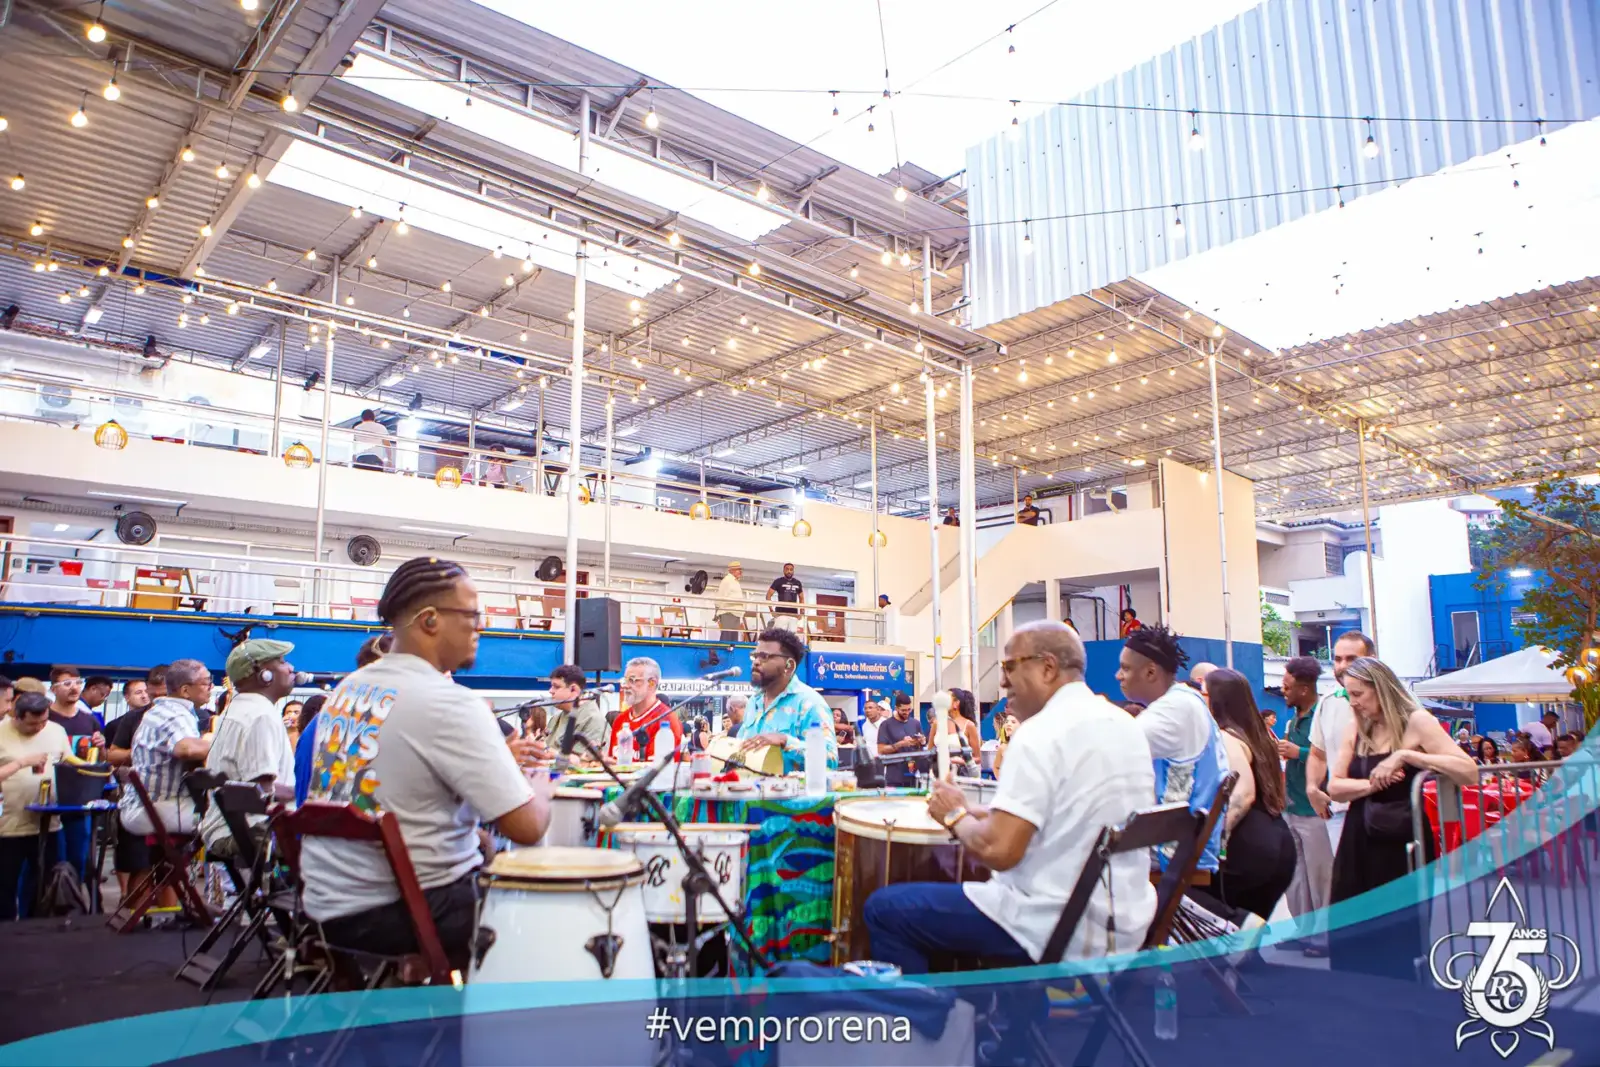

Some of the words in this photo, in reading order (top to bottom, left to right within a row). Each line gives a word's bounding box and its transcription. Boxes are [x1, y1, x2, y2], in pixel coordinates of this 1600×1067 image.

[830, 661, 850, 672] Centro
[851, 662, 859, 672] de
[860, 661, 888, 673] Memórias
